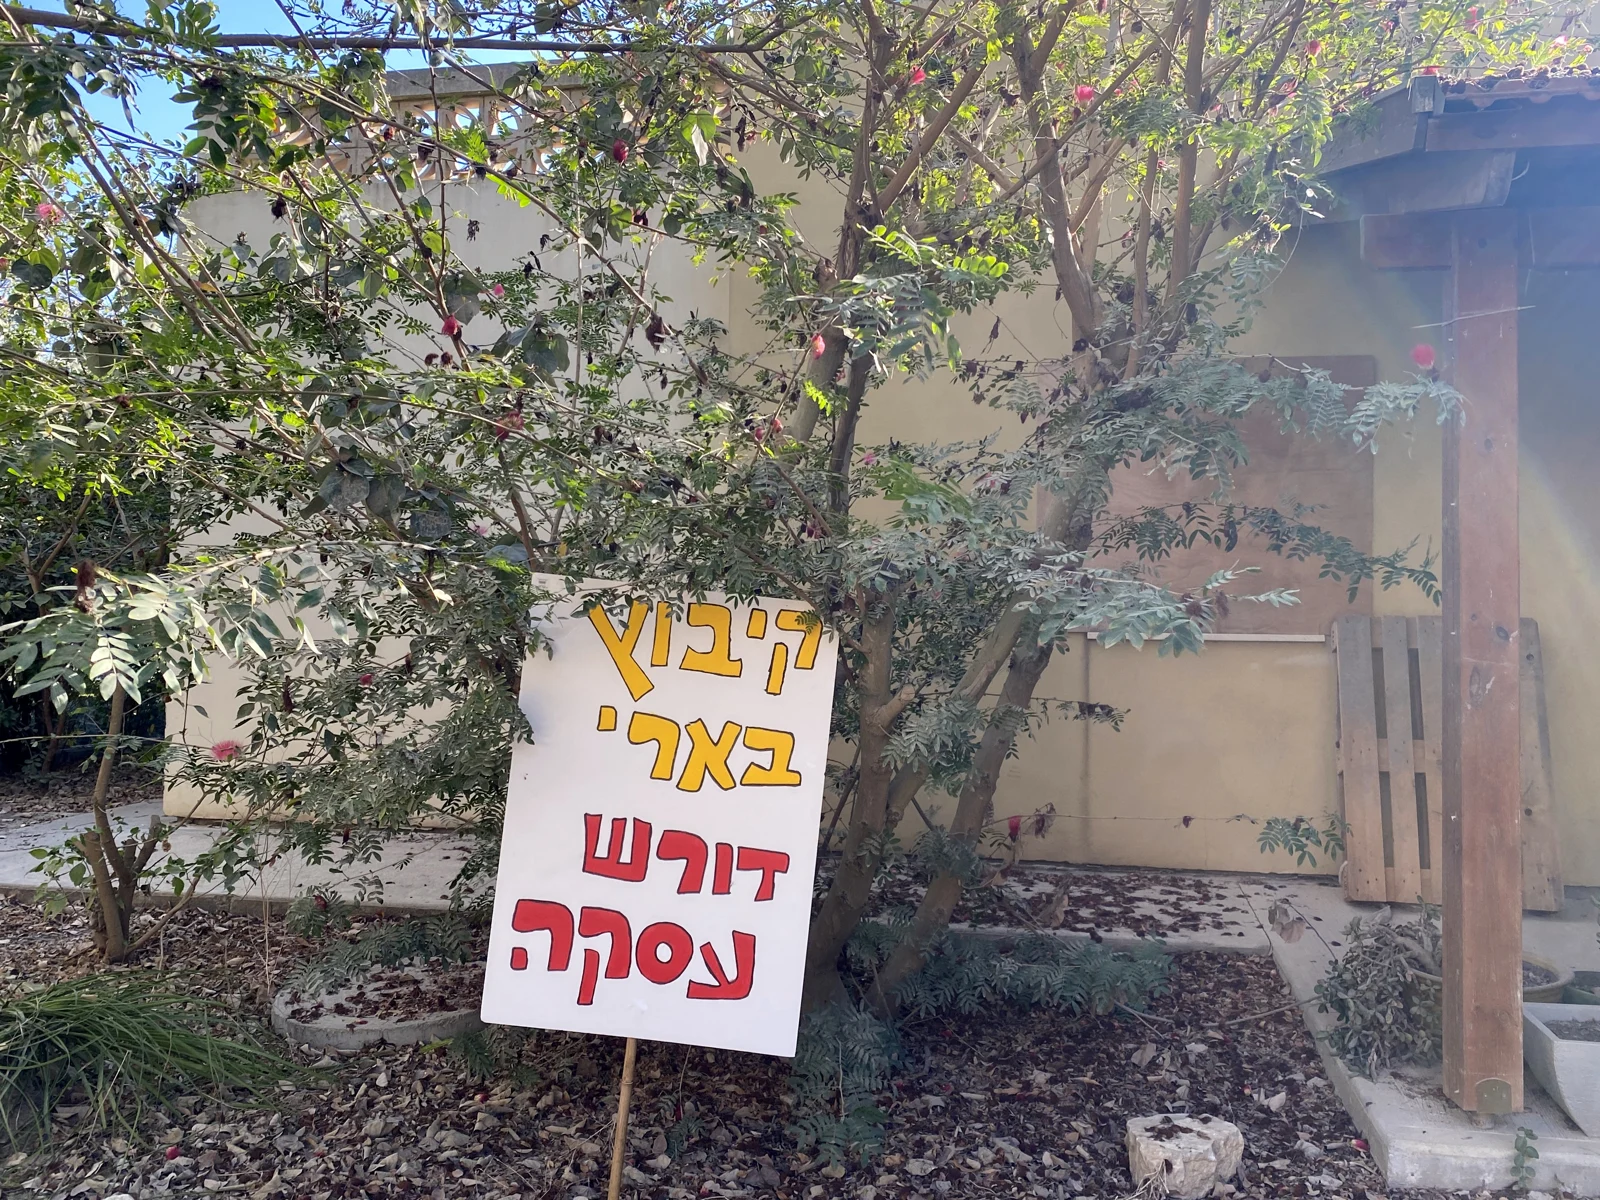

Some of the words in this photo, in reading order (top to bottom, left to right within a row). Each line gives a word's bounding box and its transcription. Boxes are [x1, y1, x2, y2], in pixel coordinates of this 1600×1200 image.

[586, 600, 824, 702] קיבוץ
[597, 705, 802, 793] בארי
[582, 813, 790, 902] דורש
[510, 898, 756, 1006] עסקה
